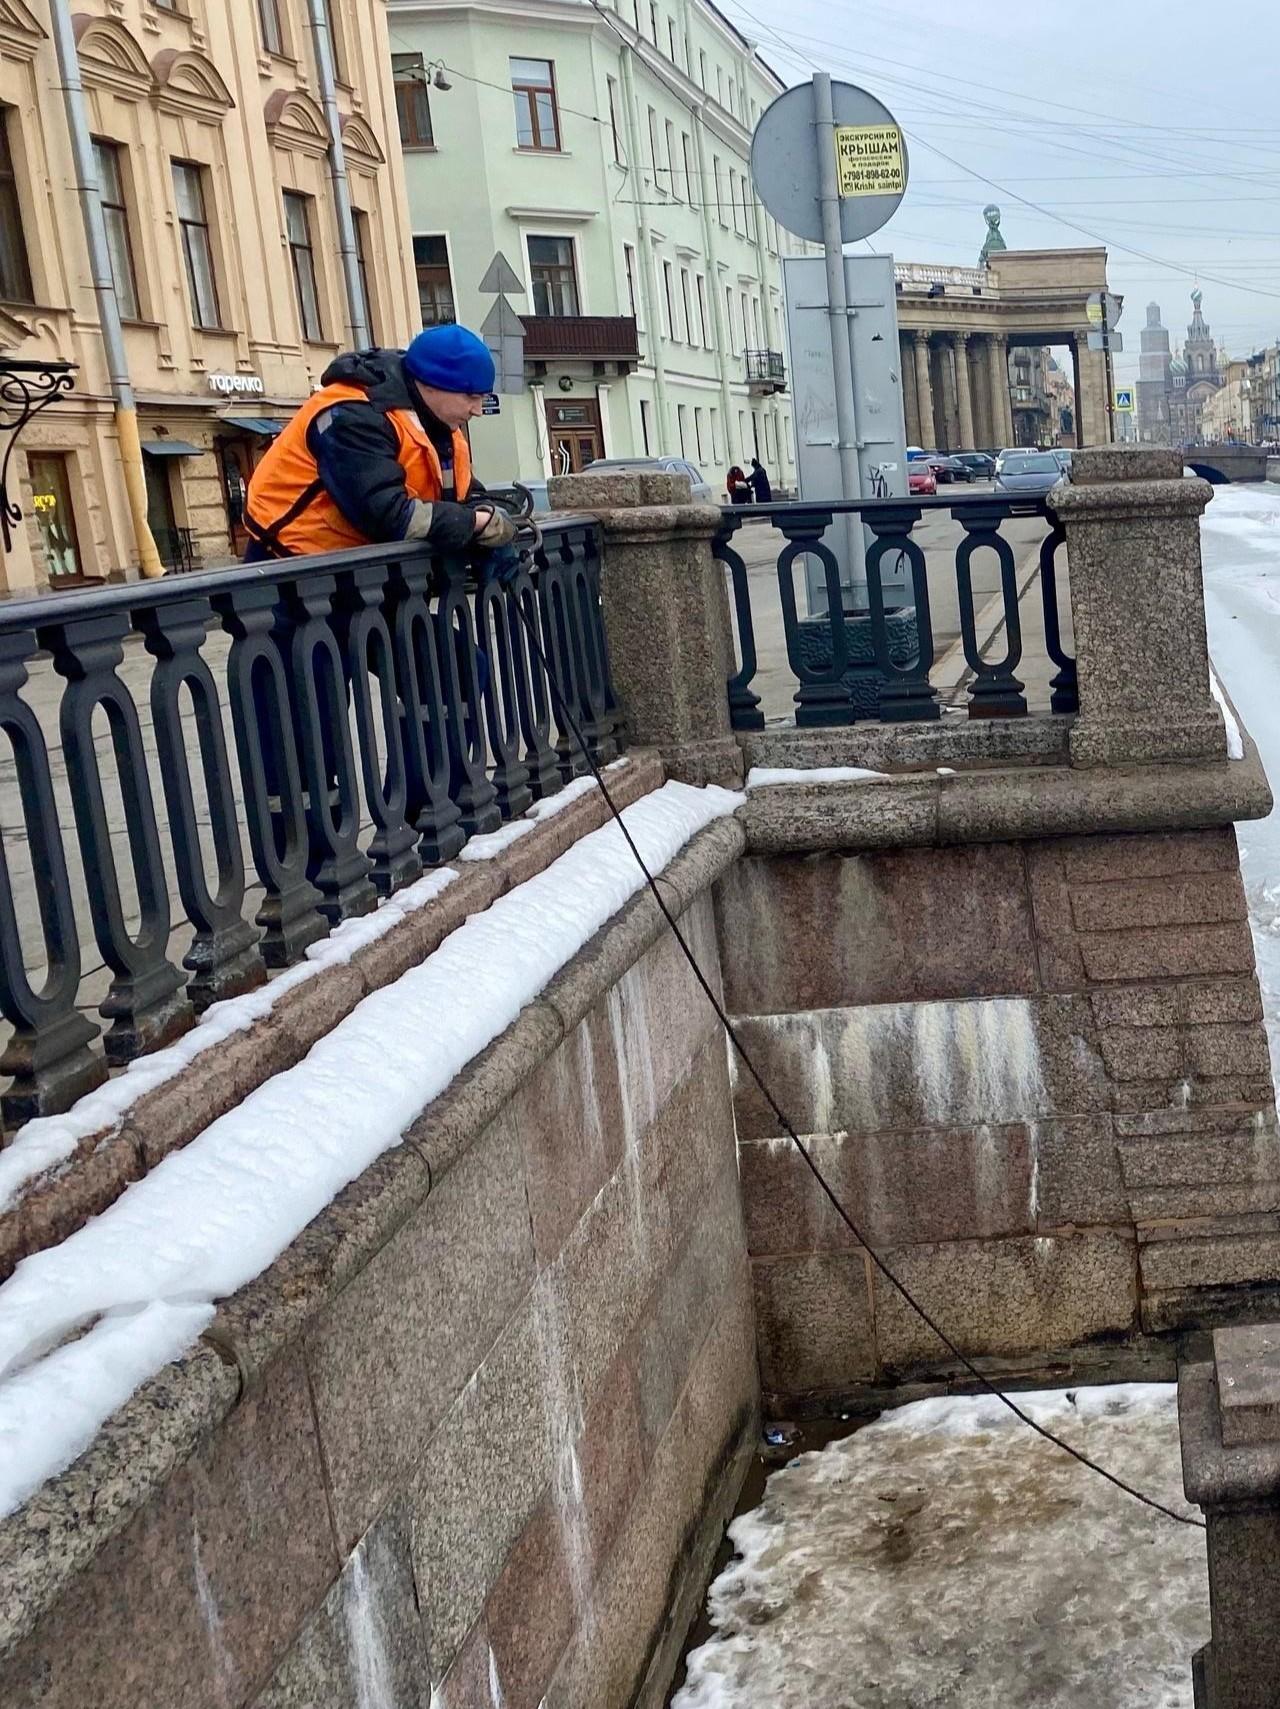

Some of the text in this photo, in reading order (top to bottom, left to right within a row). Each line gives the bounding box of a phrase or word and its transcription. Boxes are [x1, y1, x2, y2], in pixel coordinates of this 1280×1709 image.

[840, 131, 897, 141] ЭКСКУРСИИ ПО
[840, 142, 898, 155] КРЫШАМ
